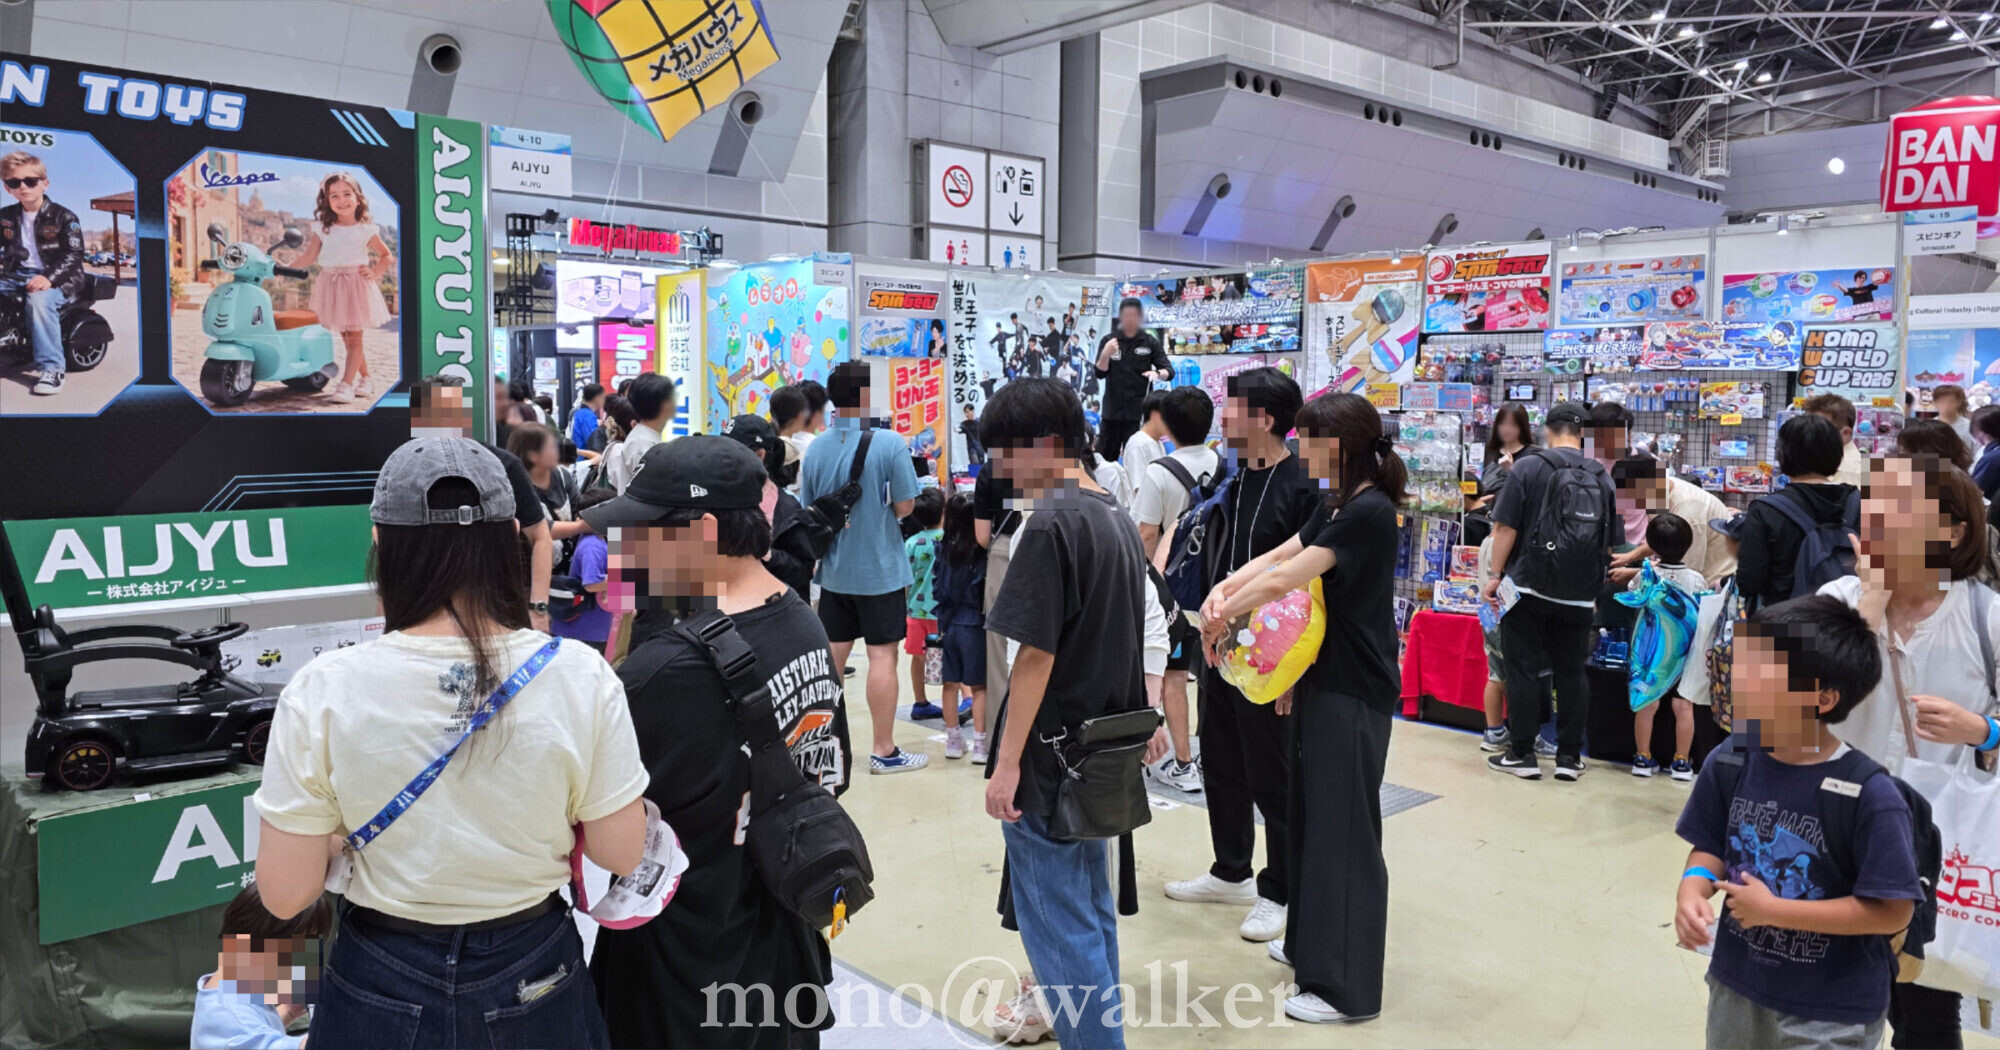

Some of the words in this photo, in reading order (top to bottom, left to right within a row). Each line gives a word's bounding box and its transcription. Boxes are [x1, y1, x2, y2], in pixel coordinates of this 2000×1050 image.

[648, 1, 744, 82] メガハウス
[678, 39, 734, 82] MegaHouse
[78, 71, 247, 131] TOYS
[518, 134, 542, 145] 4-10
[1898, 124, 1997, 166] BAN
[200, 162, 281, 188] Vespa
[511, 161, 550, 175] AIJYU
[1894, 164, 1970, 204] DAI
[433, 126, 473, 316] AIJYU
[567, 217, 681, 255] MegaHouse
[1915, 231, 1962, 242] スピンギア
[952, 279, 968, 404] 世界一を決める
[1805, 329, 1878, 349] HOMA
[1799, 368, 1850, 388] CUP
[1850, 370, 1896, 388] 2026
[1802, 349, 1889, 369] WORLD
[34, 517, 288, 584] AIJYU
